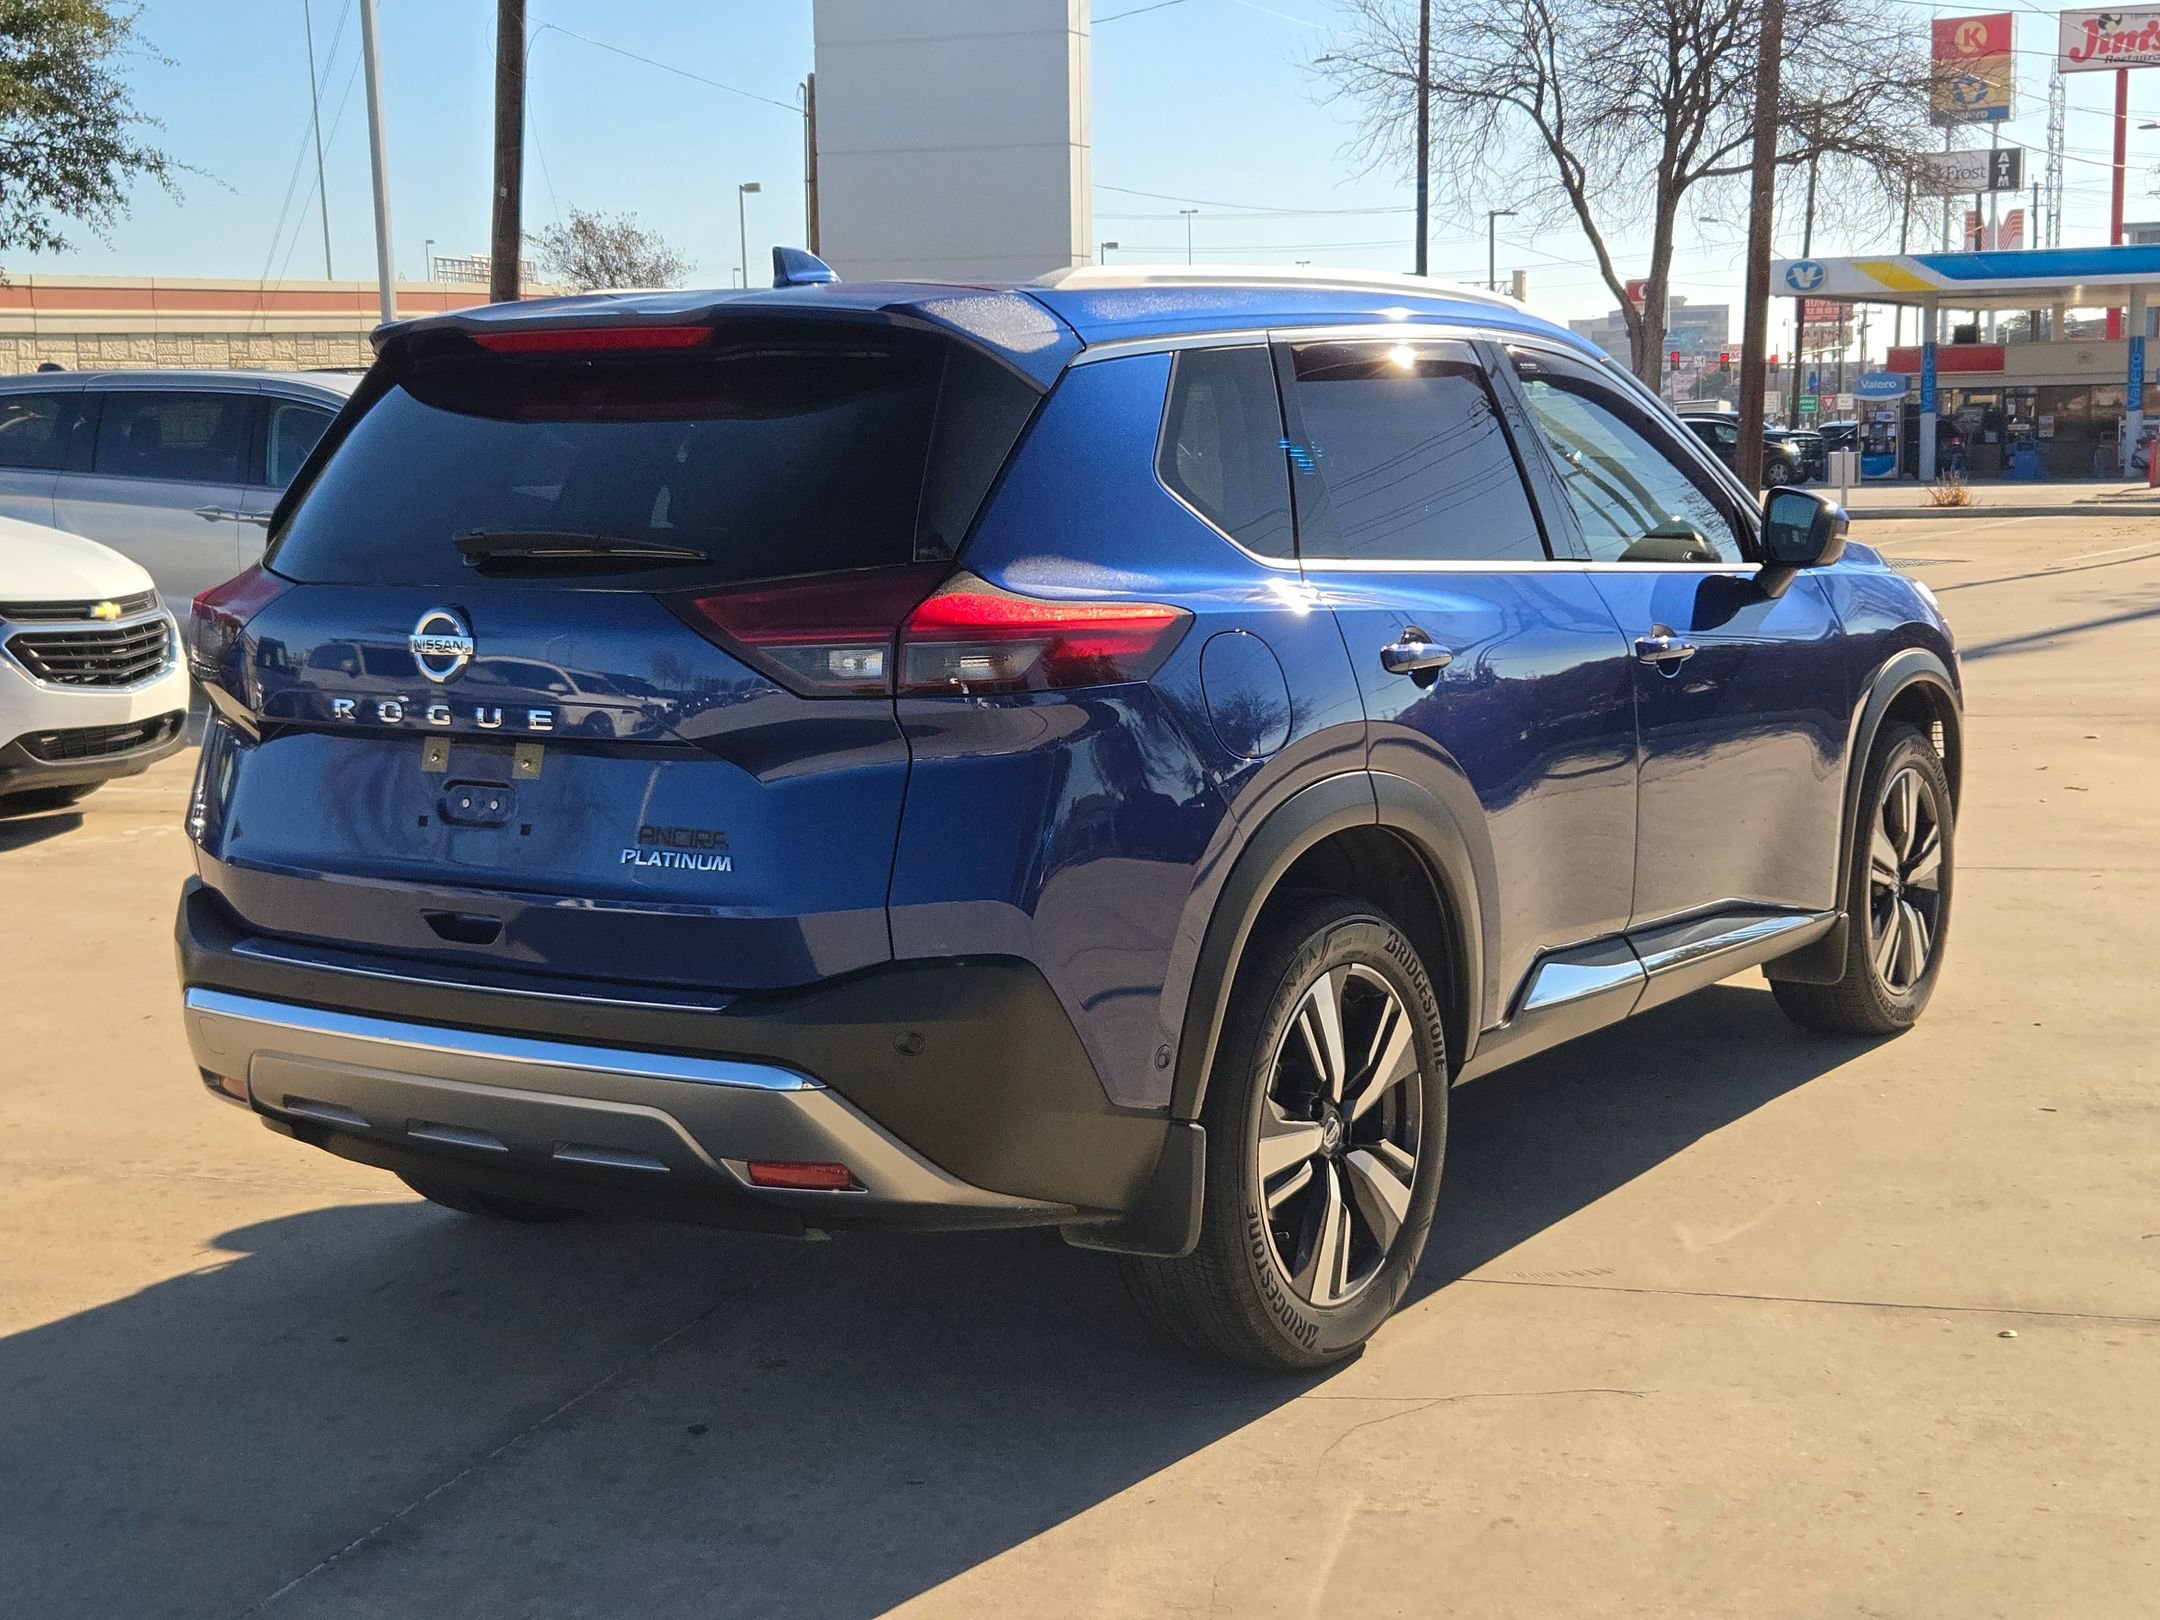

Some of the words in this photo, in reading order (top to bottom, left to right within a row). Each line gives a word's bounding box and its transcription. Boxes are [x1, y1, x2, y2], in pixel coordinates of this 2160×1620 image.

[1947, 165, 1987, 180] Frost
[1997, 152, 2010, 188] ATM
[1860, 380, 1897, 389] Valero
[414, 638, 464, 652] NISSAN
[334, 698, 554, 731] ROGUE
[620, 848, 733, 872] PLATINUM
[1383, 929, 1446, 1074] BRIDGESTONE
[1245, 1204, 1320, 1350] BRIDGESTONE
